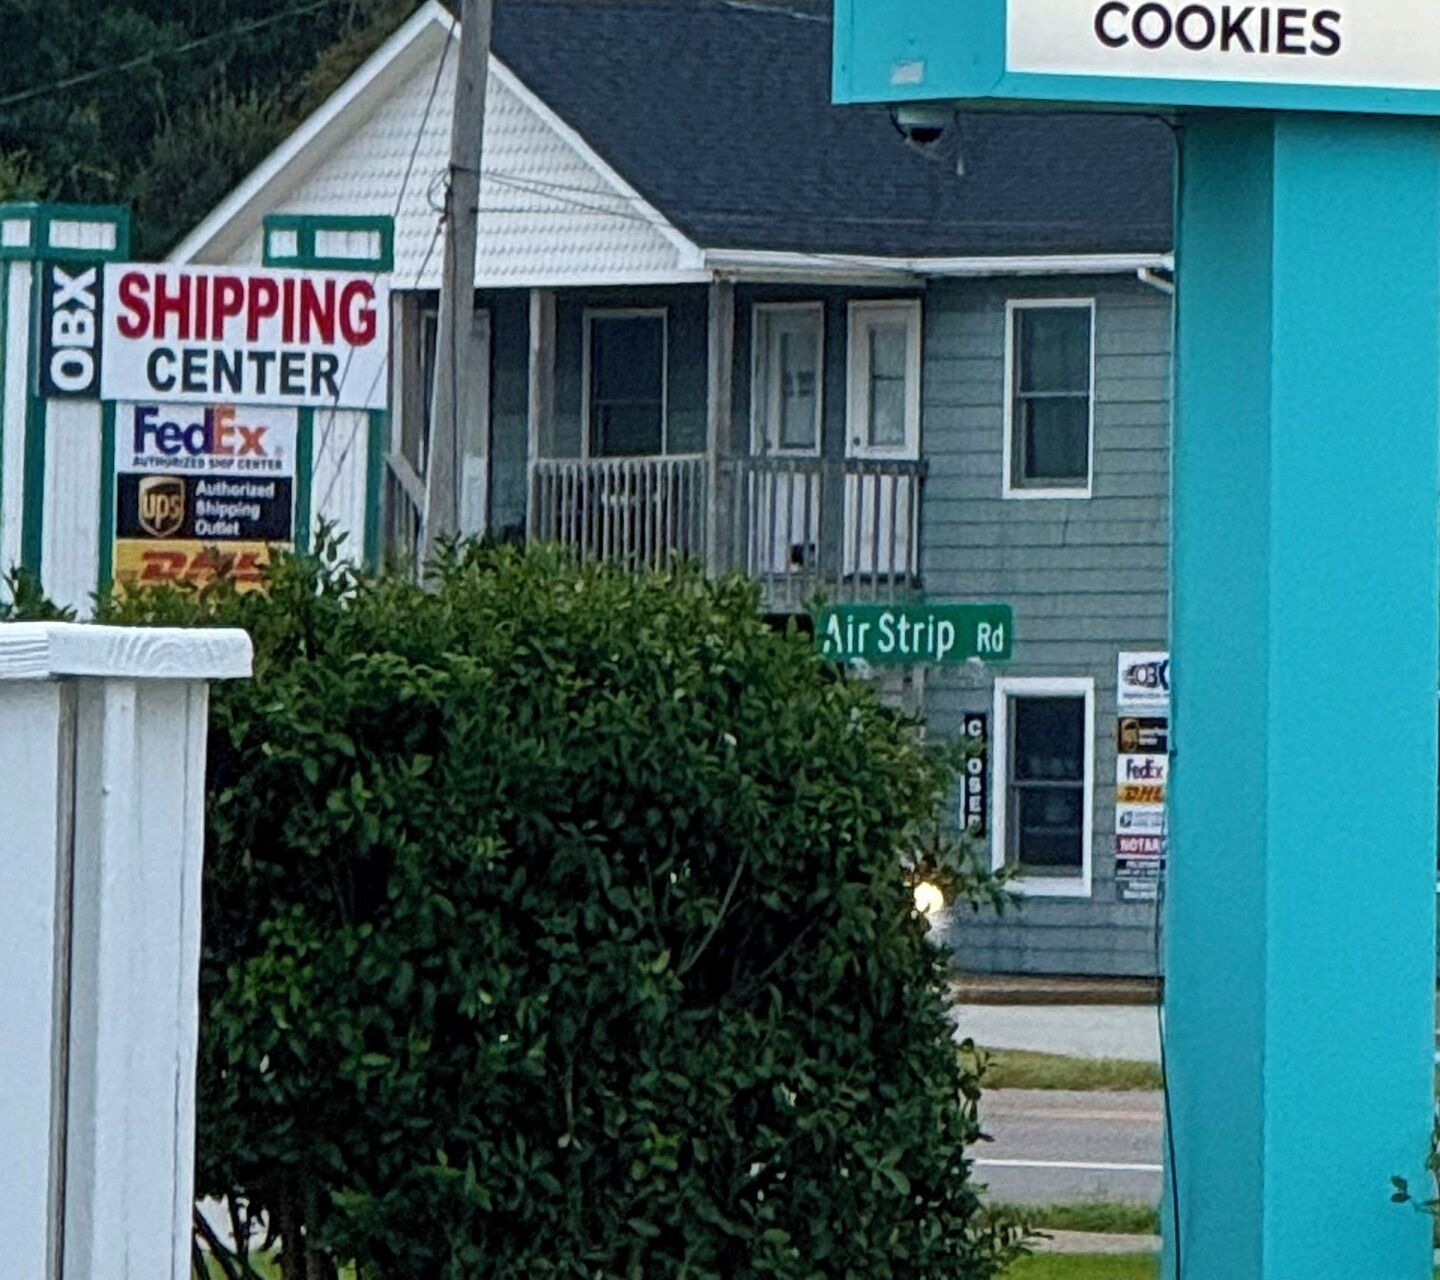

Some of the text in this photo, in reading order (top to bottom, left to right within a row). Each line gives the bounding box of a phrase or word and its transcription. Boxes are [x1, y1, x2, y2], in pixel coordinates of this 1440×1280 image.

[1092, 0, 1342, 56] COOKIES
[50, 266, 97, 392] OBX
[116, 271, 378, 347] SHIPPING
[146, 347, 341, 398] CENTER
[133, 403, 270, 457] FedEx
[195, 479, 276, 500] Authorized
[195, 499, 261, 521] Shipping
[823, 612, 1005, 661] Air Strip Rd
[1125, 758, 1164, 780] FedEx
